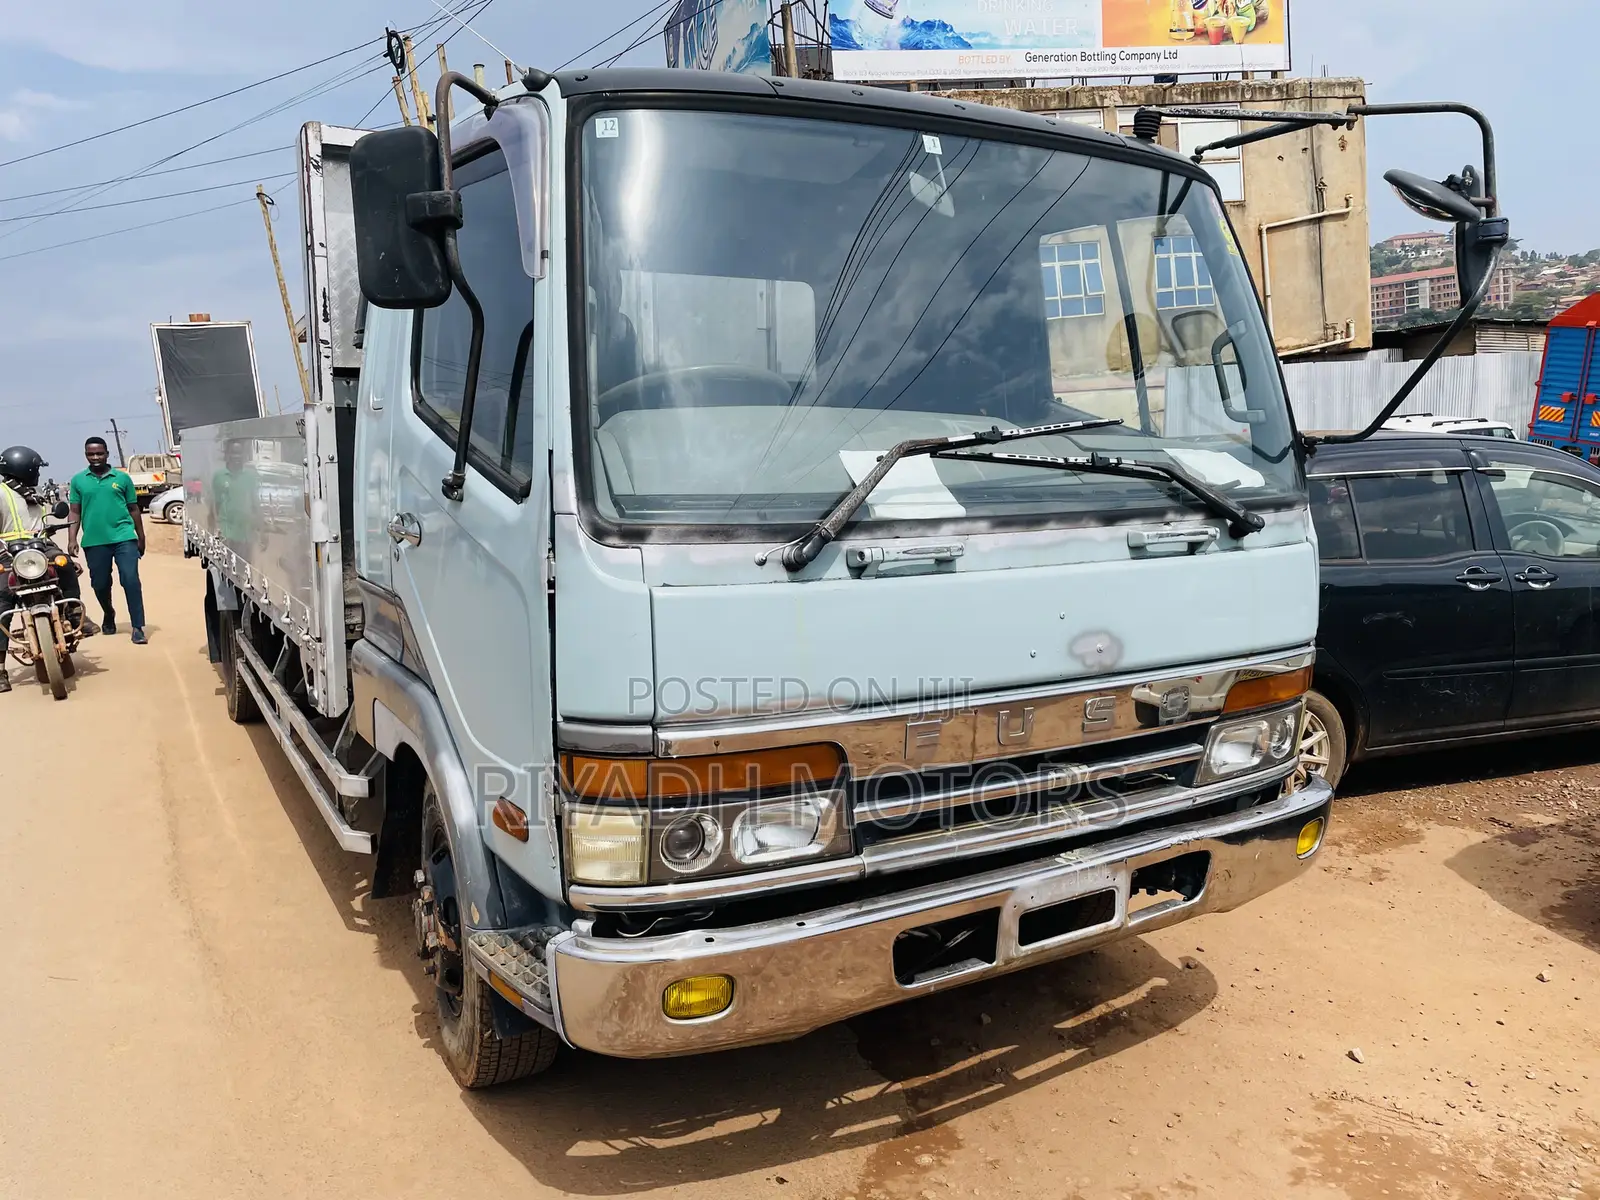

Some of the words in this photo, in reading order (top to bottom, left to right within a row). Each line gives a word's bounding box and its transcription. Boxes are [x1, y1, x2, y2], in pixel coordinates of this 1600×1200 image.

[977, 0, 1054, 13] DRINKING
[1004, 17, 1079, 36] WATER
[958, 54, 998, 65] BOTTLED
[1024, 51, 1078, 64] Generation
[1080, 51, 1117, 65] Bottling
[1119, 50, 1162, 63] Company
[1163, 49, 1178, 61] Ltd
[603, 119, 616, 131] 12
